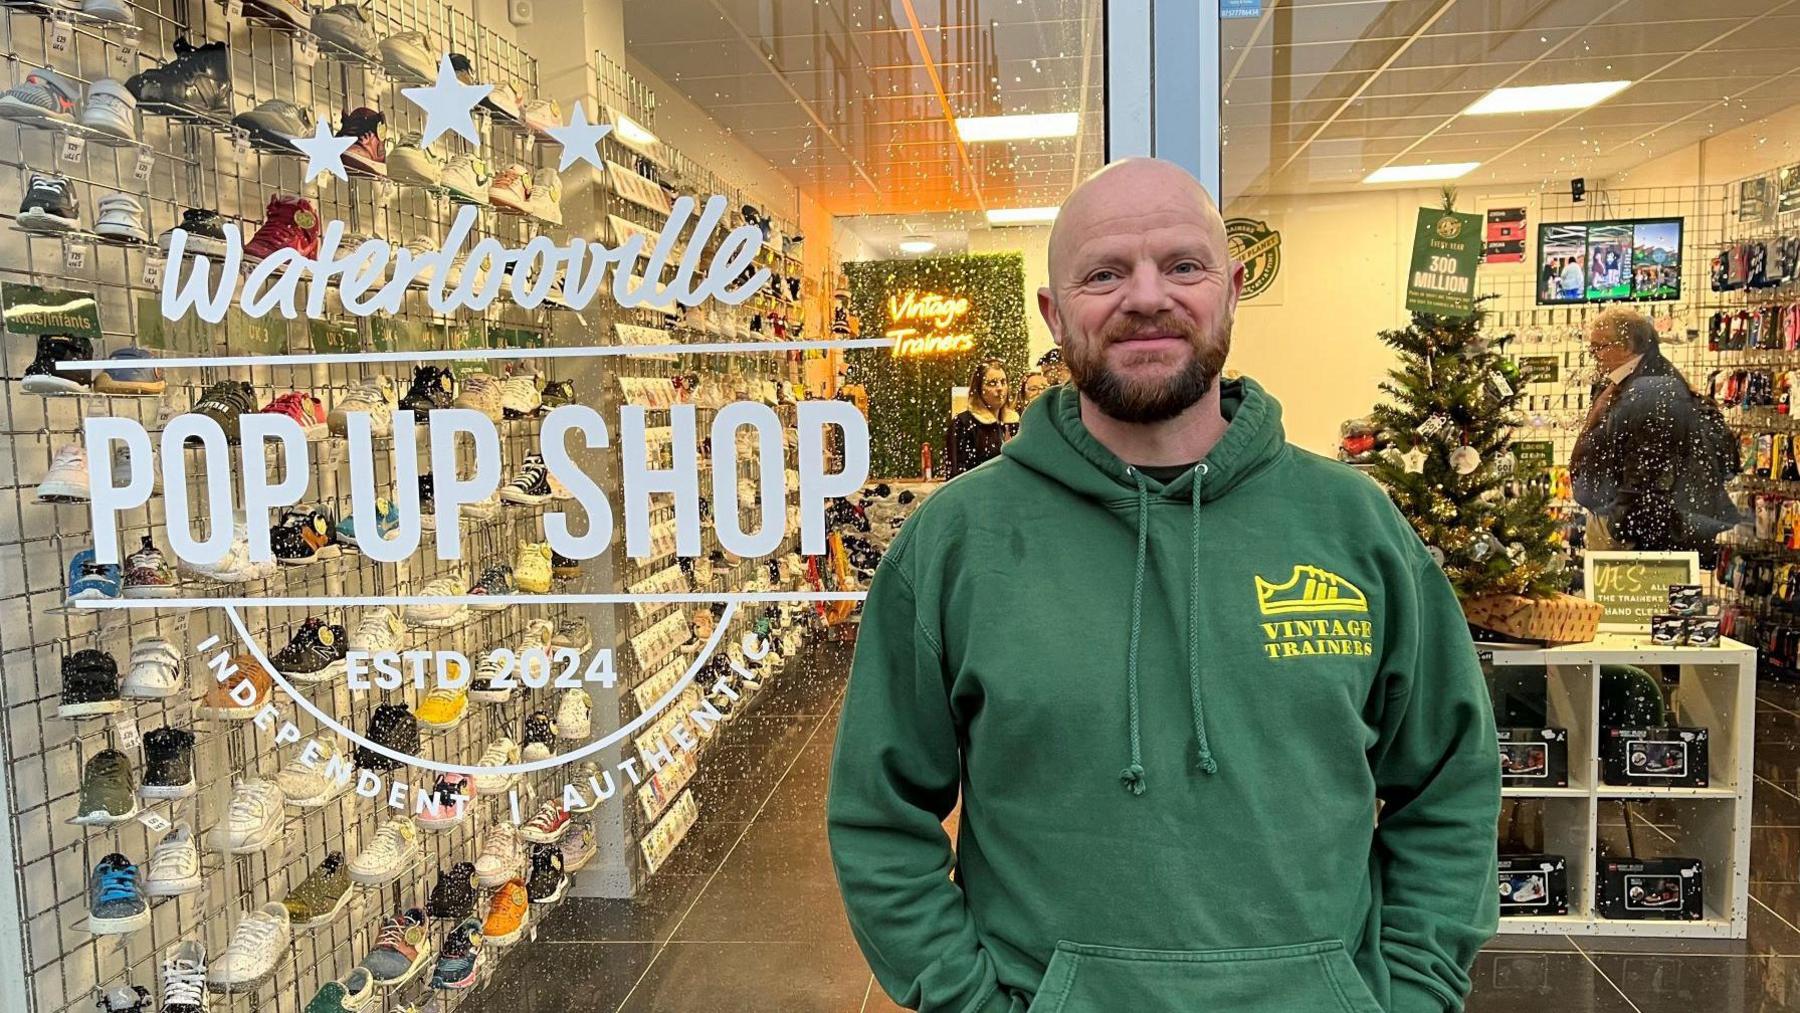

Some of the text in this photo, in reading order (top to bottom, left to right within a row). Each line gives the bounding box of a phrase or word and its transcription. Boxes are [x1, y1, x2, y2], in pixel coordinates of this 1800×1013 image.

[161, 194, 770, 325] Waterlooville
[1429, 255, 1457, 274] 300
[1414, 271, 1469, 294] MILLION
[890, 291, 968, 328] Vintage
[886, 328, 976, 358] Trainers
[85, 403, 871, 566] POP UP SHOP
[1604, 607, 1632, 616] HAND
[1618, 594, 1664, 603] TRAINERS
[1259, 619, 1372, 640] VINTAGE
[1264, 639, 1372, 658] TRAINERS
[345, 647, 617, 690] ESTD 2024
[196, 634, 471, 821] INDEPENDENT
[562, 632, 770, 813] AUTHENTIC
